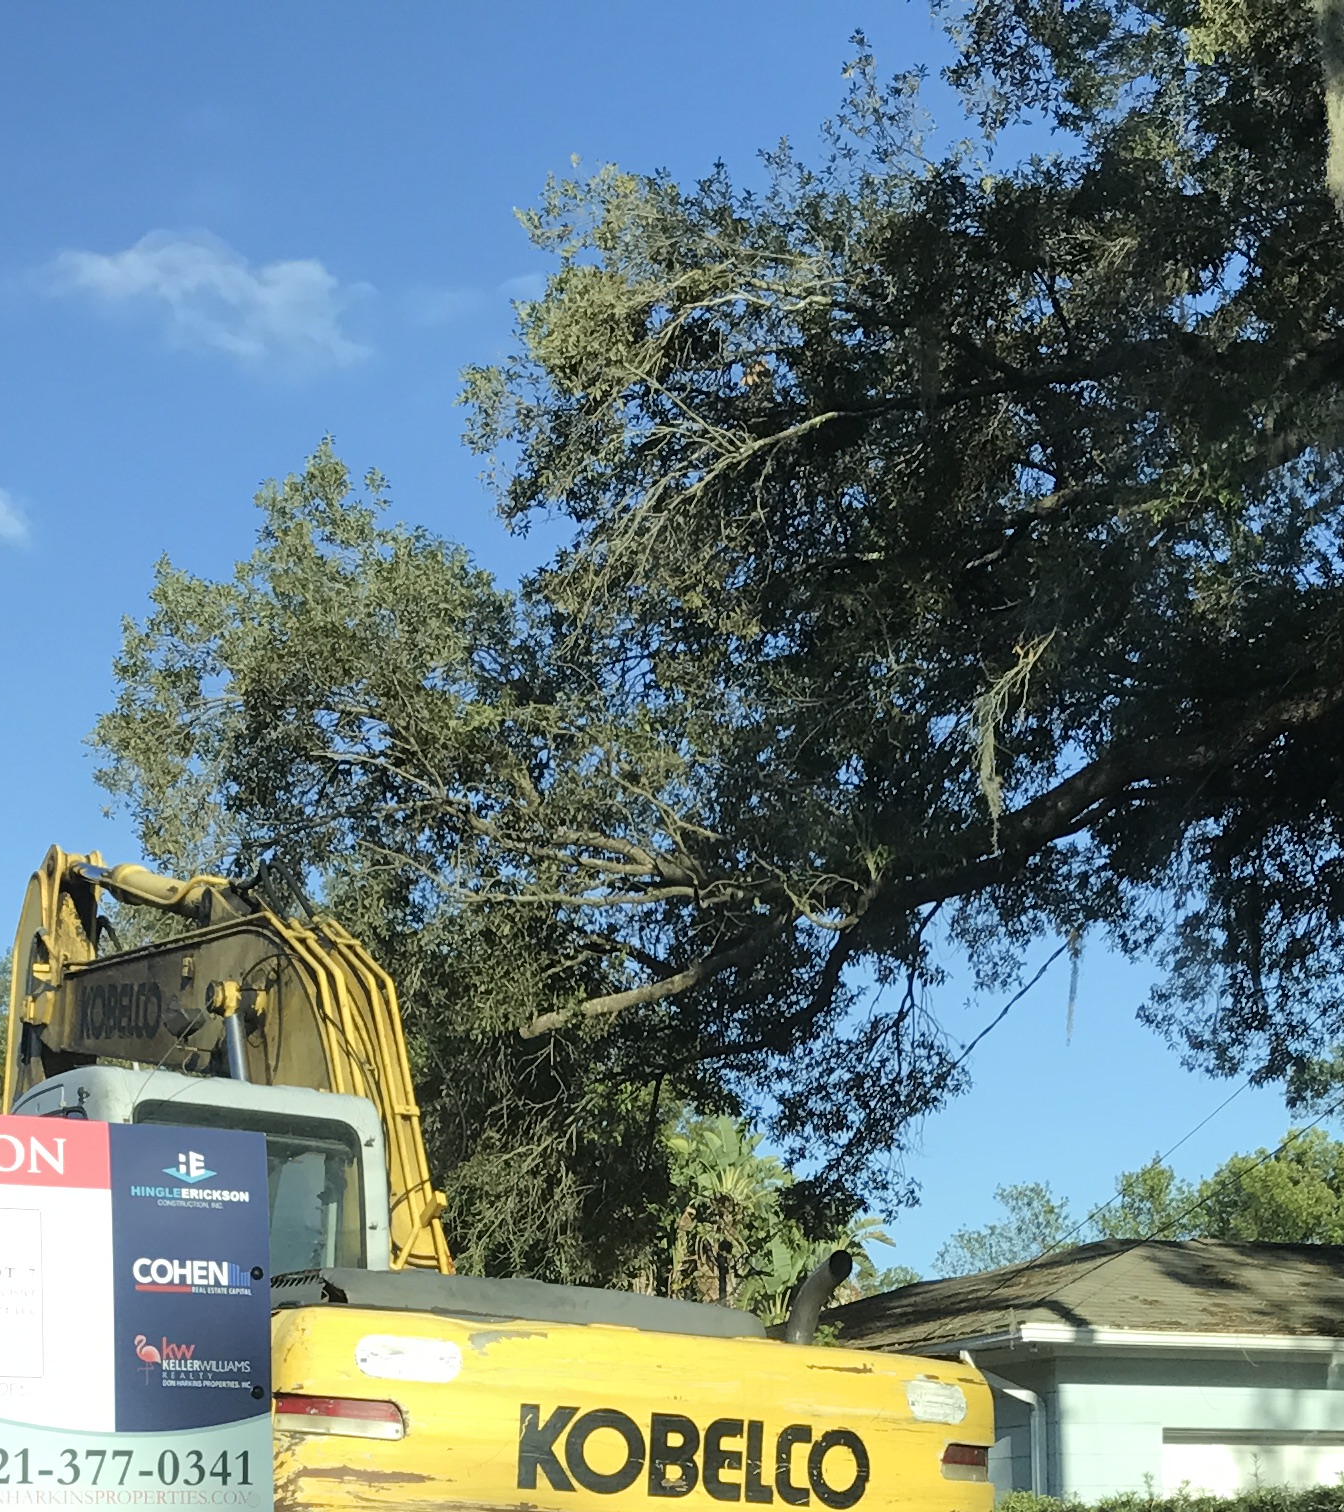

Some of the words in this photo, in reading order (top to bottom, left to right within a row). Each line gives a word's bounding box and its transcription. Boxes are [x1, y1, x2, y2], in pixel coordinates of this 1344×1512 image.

[80, 982, 162, 1039] KOBELCO
[130, 1185, 250, 1203] HINGLEERICKSON
[132, 1257, 229, 1286] COHEN
[207, 1287, 228, 1295] ESTATE
[162, 1336, 196, 1360] kw
[162, 1372, 214, 1380] REALTY
[516, 1402, 871, 1510] KOBELCO
